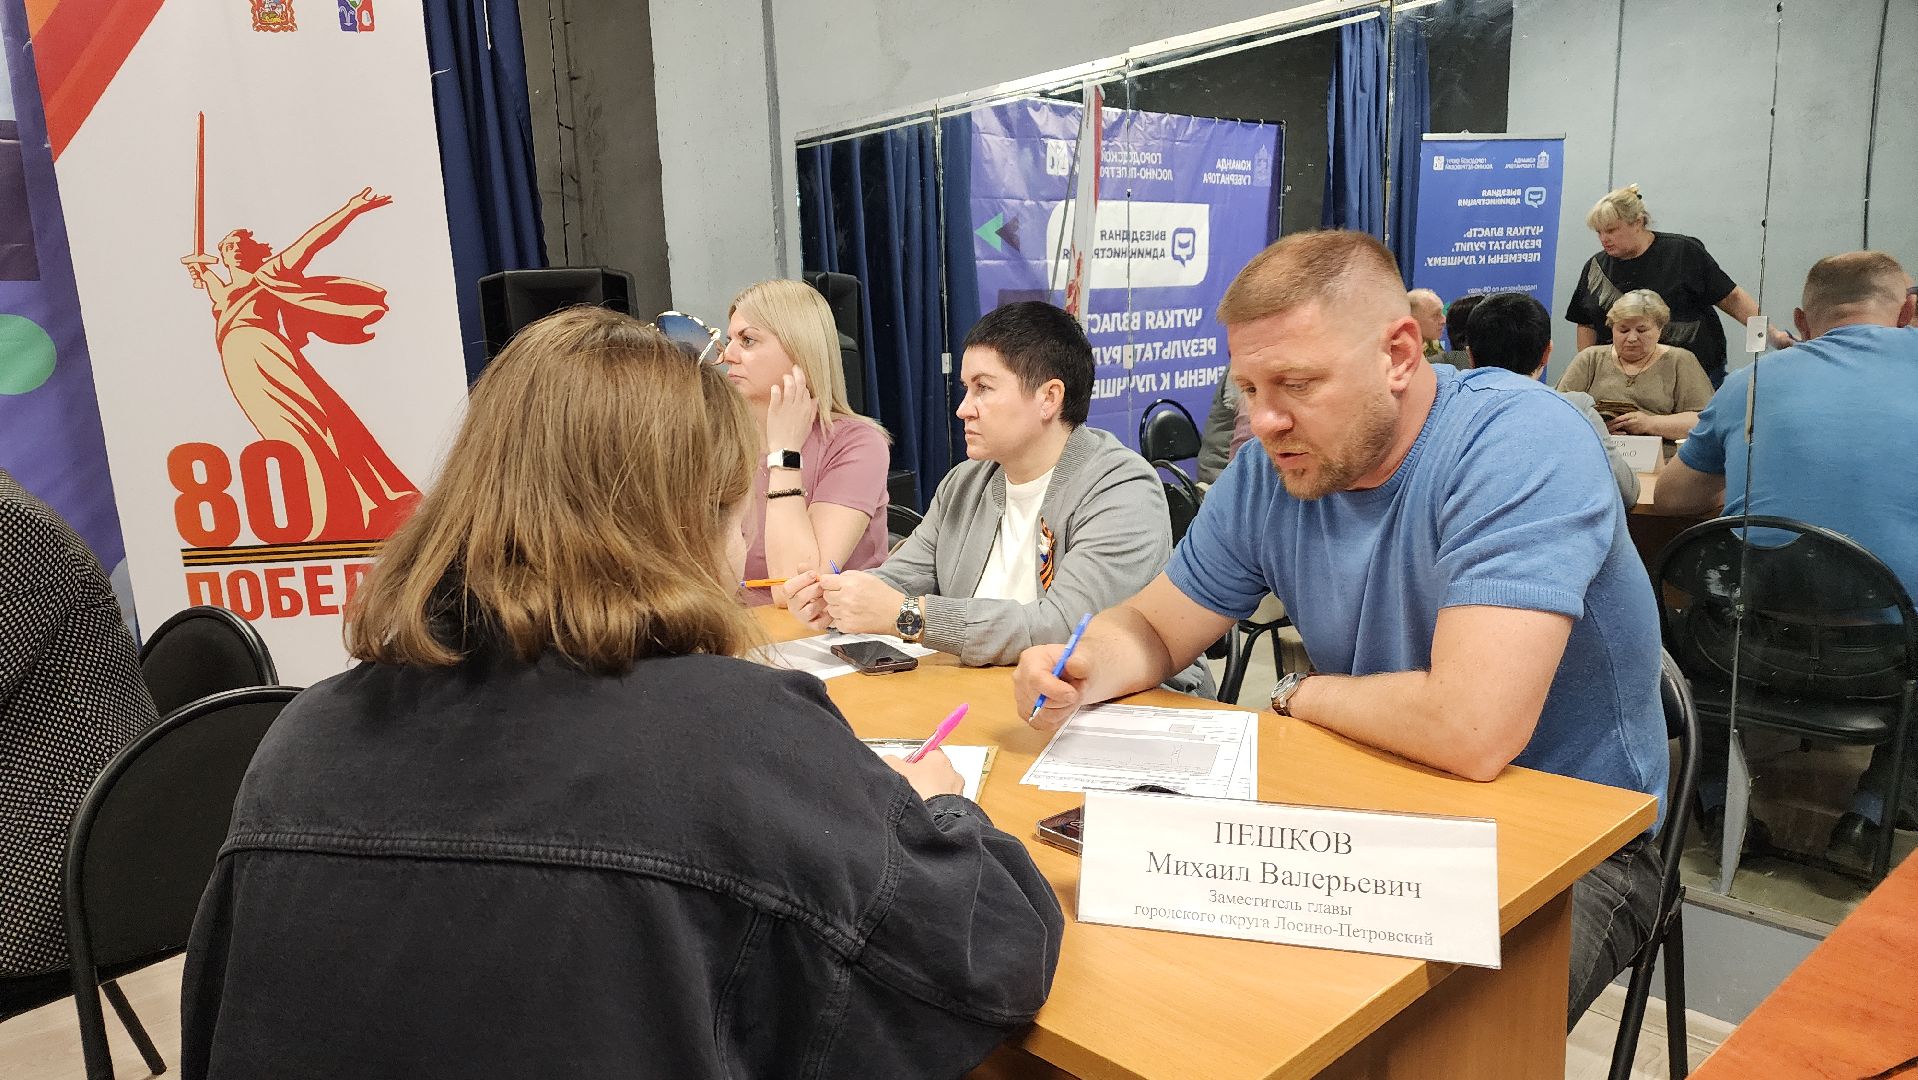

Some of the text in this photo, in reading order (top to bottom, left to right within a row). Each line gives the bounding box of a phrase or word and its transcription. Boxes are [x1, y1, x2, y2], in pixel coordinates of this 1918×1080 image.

[167, 439, 314, 549] 80
[185, 564, 374, 622] ПОБЕД
[1214, 821, 1352, 855] ПЕШКОВ
[1146, 850, 1422, 899] Михаил Валерьевич
[1208, 889, 1352, 916] Заместитель главы
[1135, 905, 1433, 946] городского округа Лосино-Петровский
